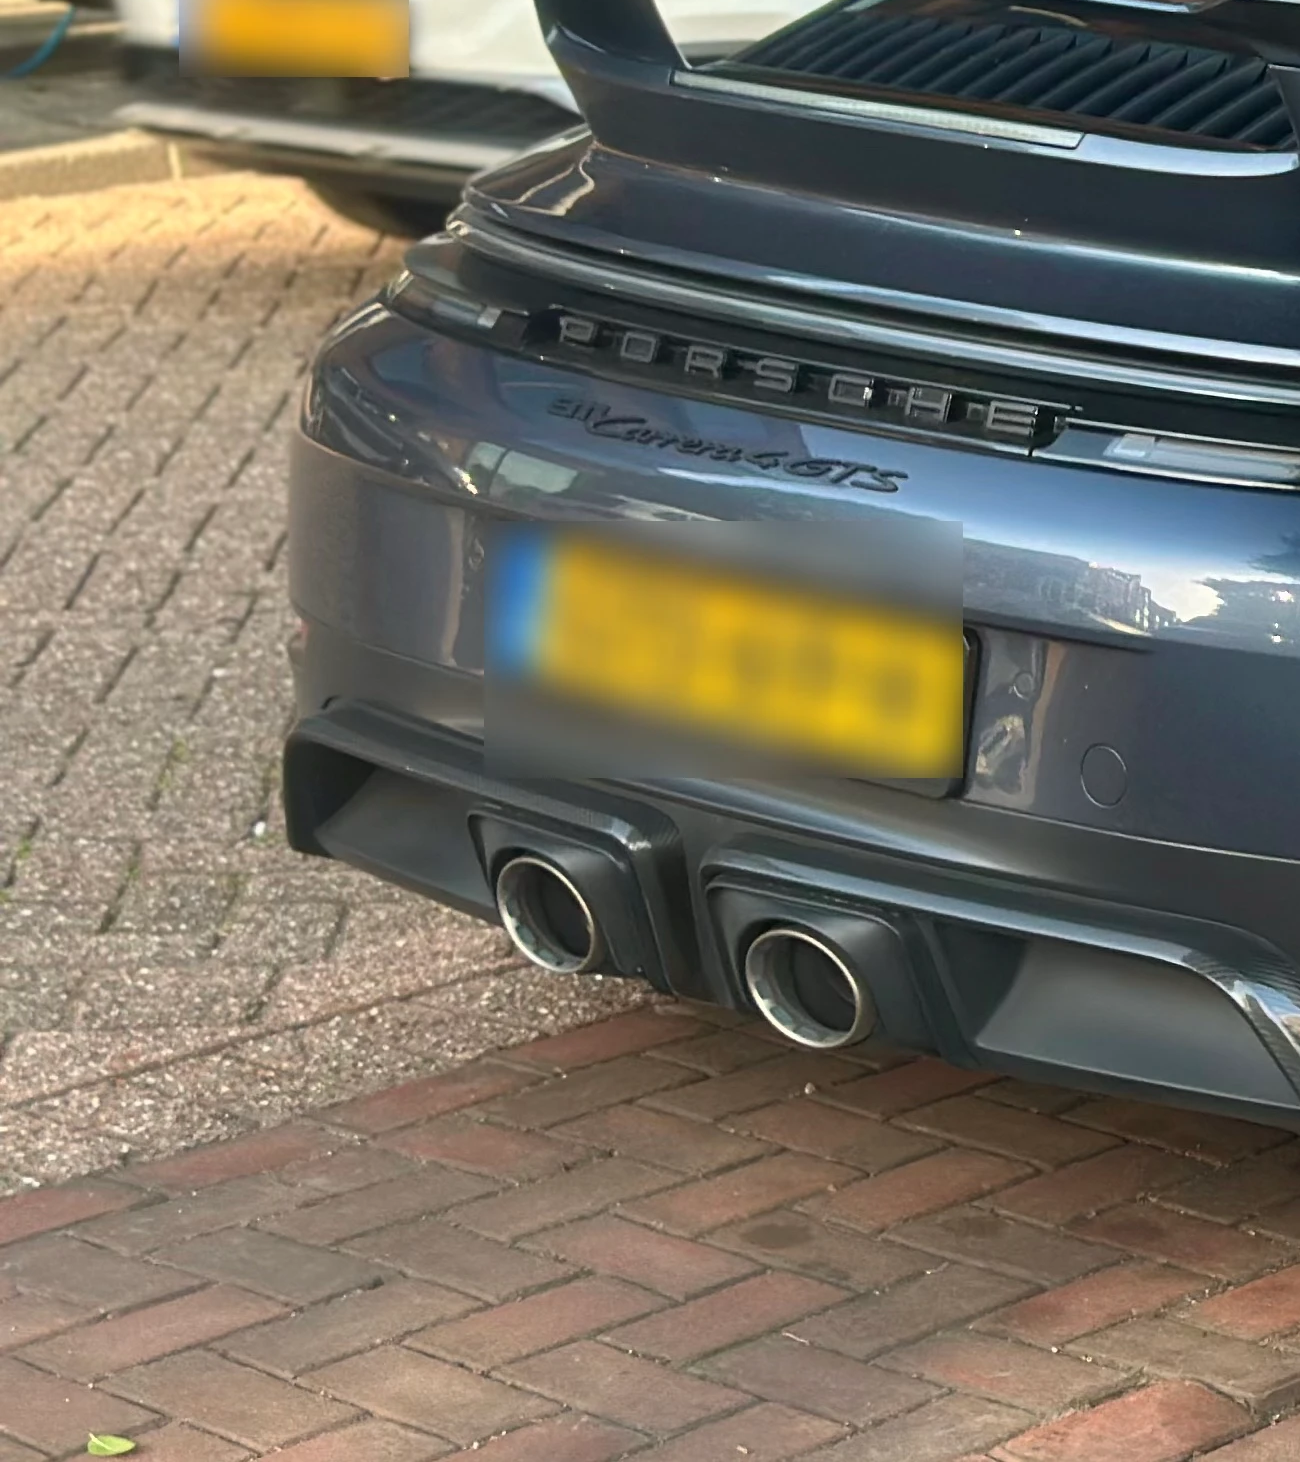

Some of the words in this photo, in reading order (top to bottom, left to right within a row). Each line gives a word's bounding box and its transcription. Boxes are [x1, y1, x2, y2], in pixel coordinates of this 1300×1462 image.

[558, 314, 1040, 436] PORSCHE
[584, 416, 743, 464] Carrera
[783, 457, 909, 494] GTS
